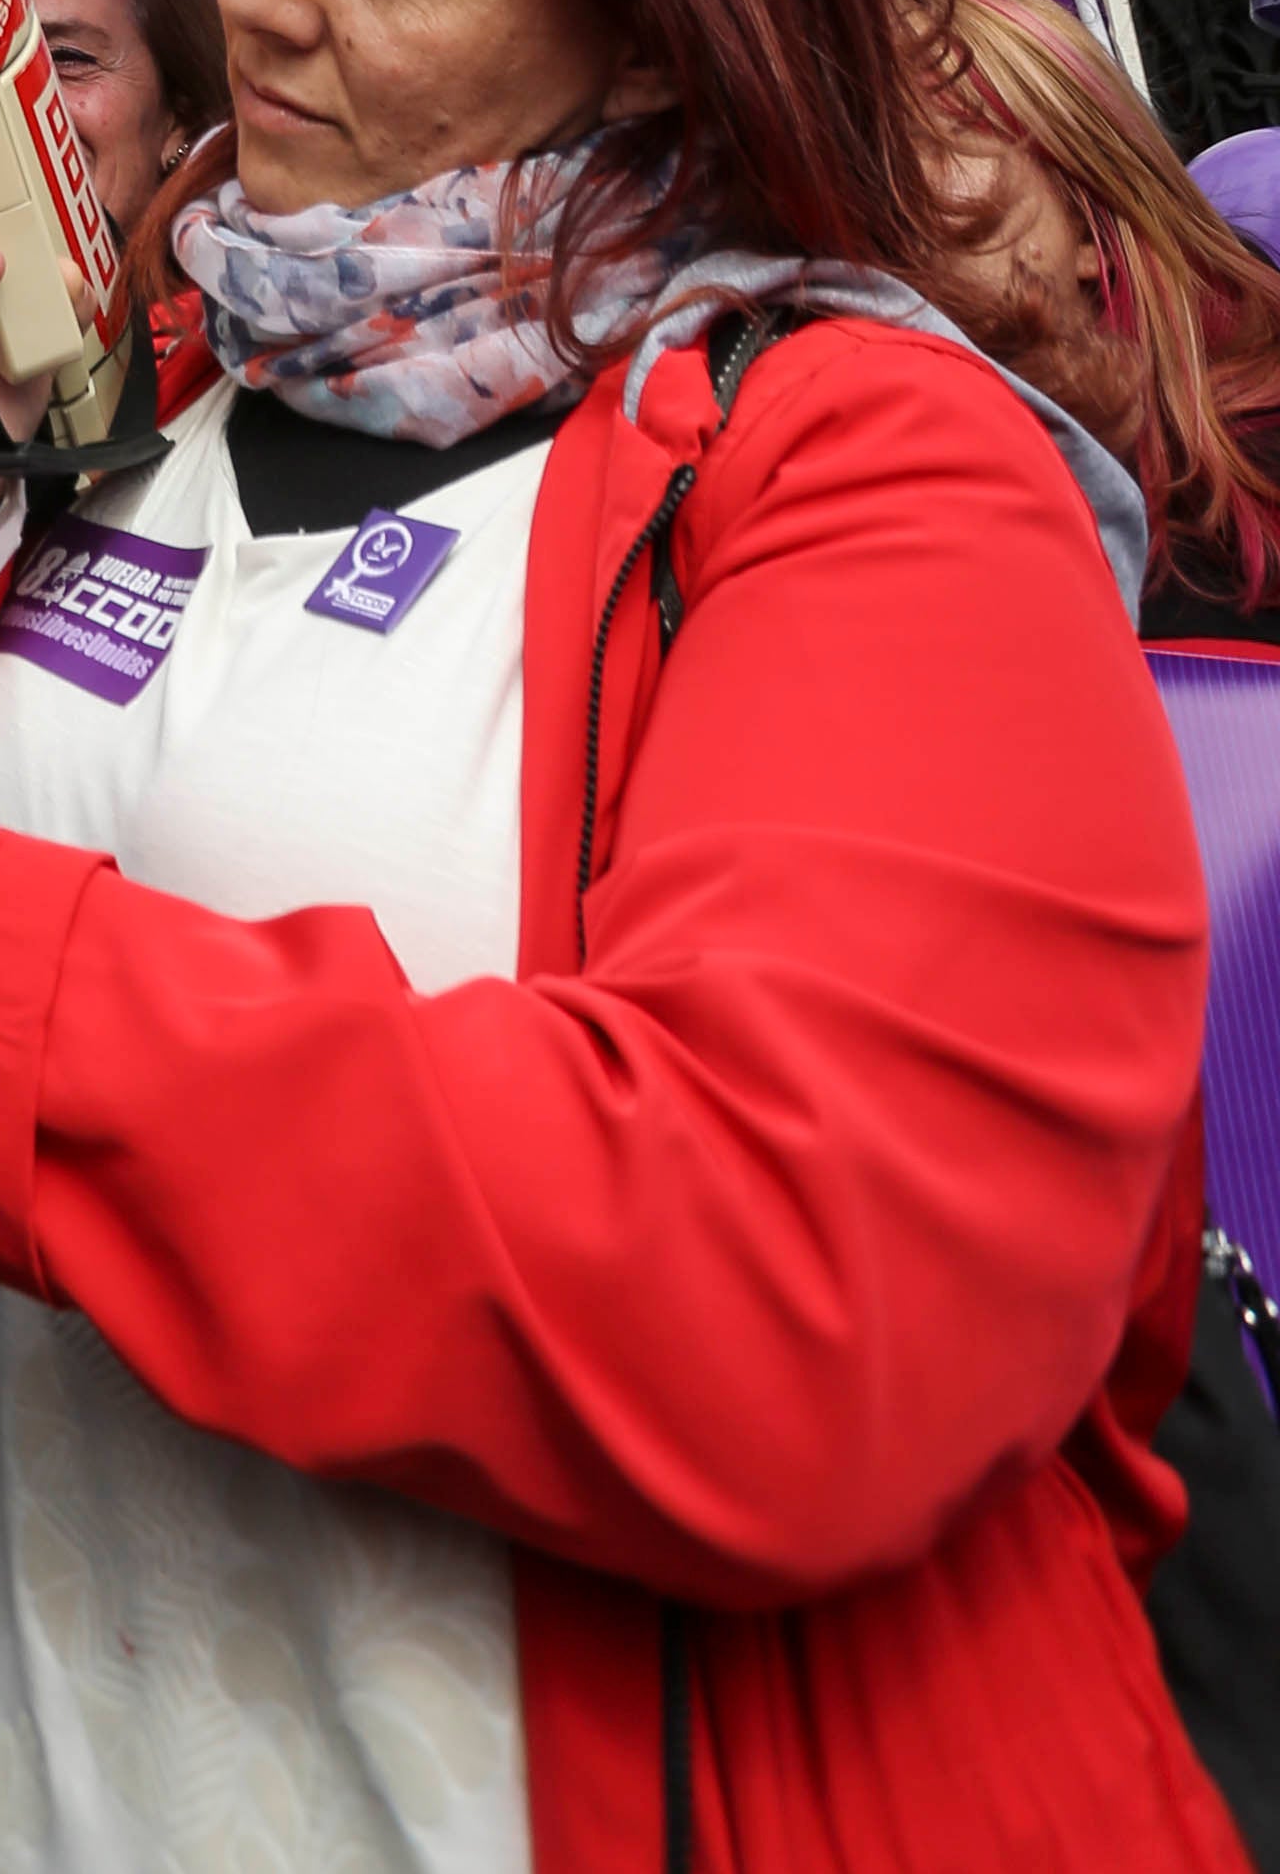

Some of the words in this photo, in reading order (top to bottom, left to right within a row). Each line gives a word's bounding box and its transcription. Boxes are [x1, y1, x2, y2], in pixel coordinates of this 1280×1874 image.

[44, 90, 118, 292] CCOO
[89, 553, 163, 598] HUELGA
[352, 592, 392, 612] CCOO
[58, 578, 184, 651] CCOO
